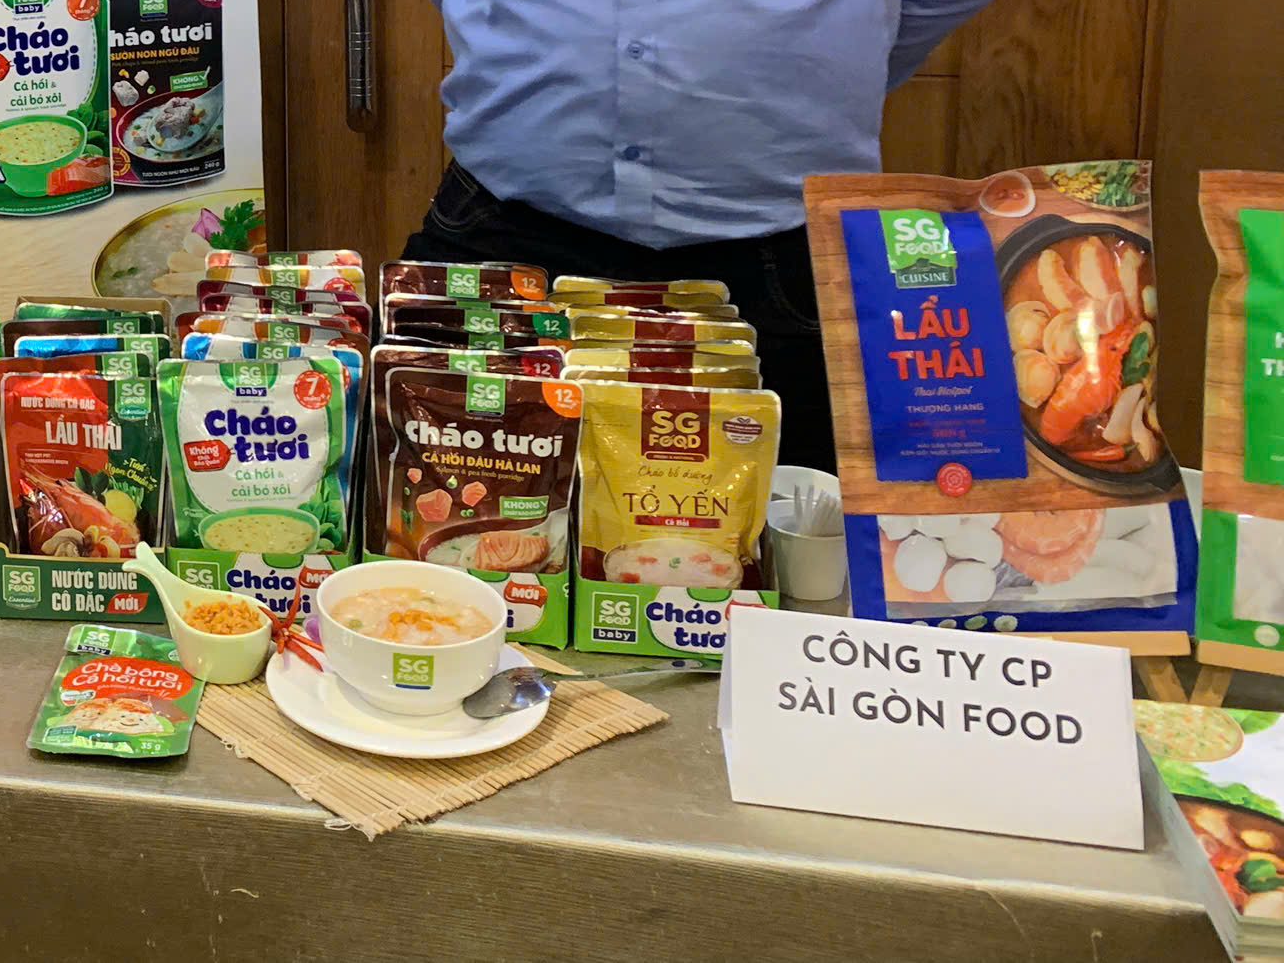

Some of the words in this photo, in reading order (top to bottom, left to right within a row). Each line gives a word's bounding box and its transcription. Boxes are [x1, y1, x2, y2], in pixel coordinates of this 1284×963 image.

[18, 5, 41, 13] baby
[160, 23, 213, 43] tươi
[14, 45, 80, 76] tươi
[137, 49, 157, 59] NON
[14, 81, 28, 92] Cá
[10, 95, 27, 107] cải
[30, 94, 44, 106] bó
[46, 92, 62, 104] xôi
[893, 218, 941, 241] SG
[895, 241, 945, 256] FOOD
[274, 257, 293, 266] SG
[277, 272, 296, 283] SG
[451, 273, 475, 287] SG
[521, 277, 537, 288] 12
[900, 272, 949, 284] CUISINE
[271, 290, 291, 301] SG
[469, 316, 494, 330] SG
[890, 294, 971, 341] LẨU
[113, 322, 135, 334] SG
[275, 326, 294, 338] SG
[543, 319, 560, 332] 12
[130, 341, 154, 353] SG
[262, 347, 285, 360] SG
[108, 357, 132, 370] SG
[454, 360, 482, 373] SG
[888, 340, 985, 380] THÁI
[239, 366, 261, 378] SG
[533, 362, 551, 375] 12
[121, 383, 146, 396] SG
[239, 388, 263, 396] baby
[305, 376, 319, 395] 7
[472, 383, 500, 399] SG
[913, 387, 935, 397] Thai
[554, 389, 573, 402] 12
[470, 398, 500, 409] FOOD
[204, 406, 297, 436] Cháo
[651, 410, 700, 434] SG
[45, 414, 78, 446] LẨU
[82, 417, 122, 450] THÁI
[405, 420, 484, 449] Cháo
[492, 429, 563, 457] tươi
[649, 434, 701, 448] FOOD
[189, 445, 220, 457] Không
[234, 433, 310, 463] tươi
[441, 452, 465, 466] HỒI
[516, 462, 541, 475] LAN
[235, 469, 252, 481] Cá
[638, 465, 665, 478] Cháo
[273, 483, 291, 496] xôi
[504, 501, 540, 509] KHÔNG
[623, 485, 660, 514] TỔ
[668, 489, 730, 516] YẾN
[9, 571, 34, 585] SG
[51, 569, 94, 590] NƯỚC
[98, 569, 138, 590] DÙNG
[185, 568, 213, 584] SG
[227, 570, 296, 590] Cháo
[8, 584, 35, 593] FOOD
[511, 585, 540, 601] MỚI
[51, 590, 72, 611] CÔ
[76, 593, 105, 614] ĐẶC
[114, 594, 139, 610] MỚI
[599, 599, 632, 616] SG
[599, 615, 631, 626] FOOD
[645, 603, 722, 625] Cháo
[87, 631, 111, 643] SG
[598, 630, 631, 641] baby
[80, 645, 108, 654] baby
[398, 658, 429, 674] SG
[802, 631, 920, 675] CÔNG
[937, 649, 984, 681] TY
[1002, 656, 1053, 689] CP
[81, 662, 122, 674] Chà
[124, 666, 179, 682] bông
[72, 673, 99, 686] Cá
[138, 678, 183, 691] tươi
[778, 677, 836, 717] SÀI
[852, 689, 945, 731] GÒN
[963, 704, 1083, 745] FOOD
[141, 742, 153, 750] 35
